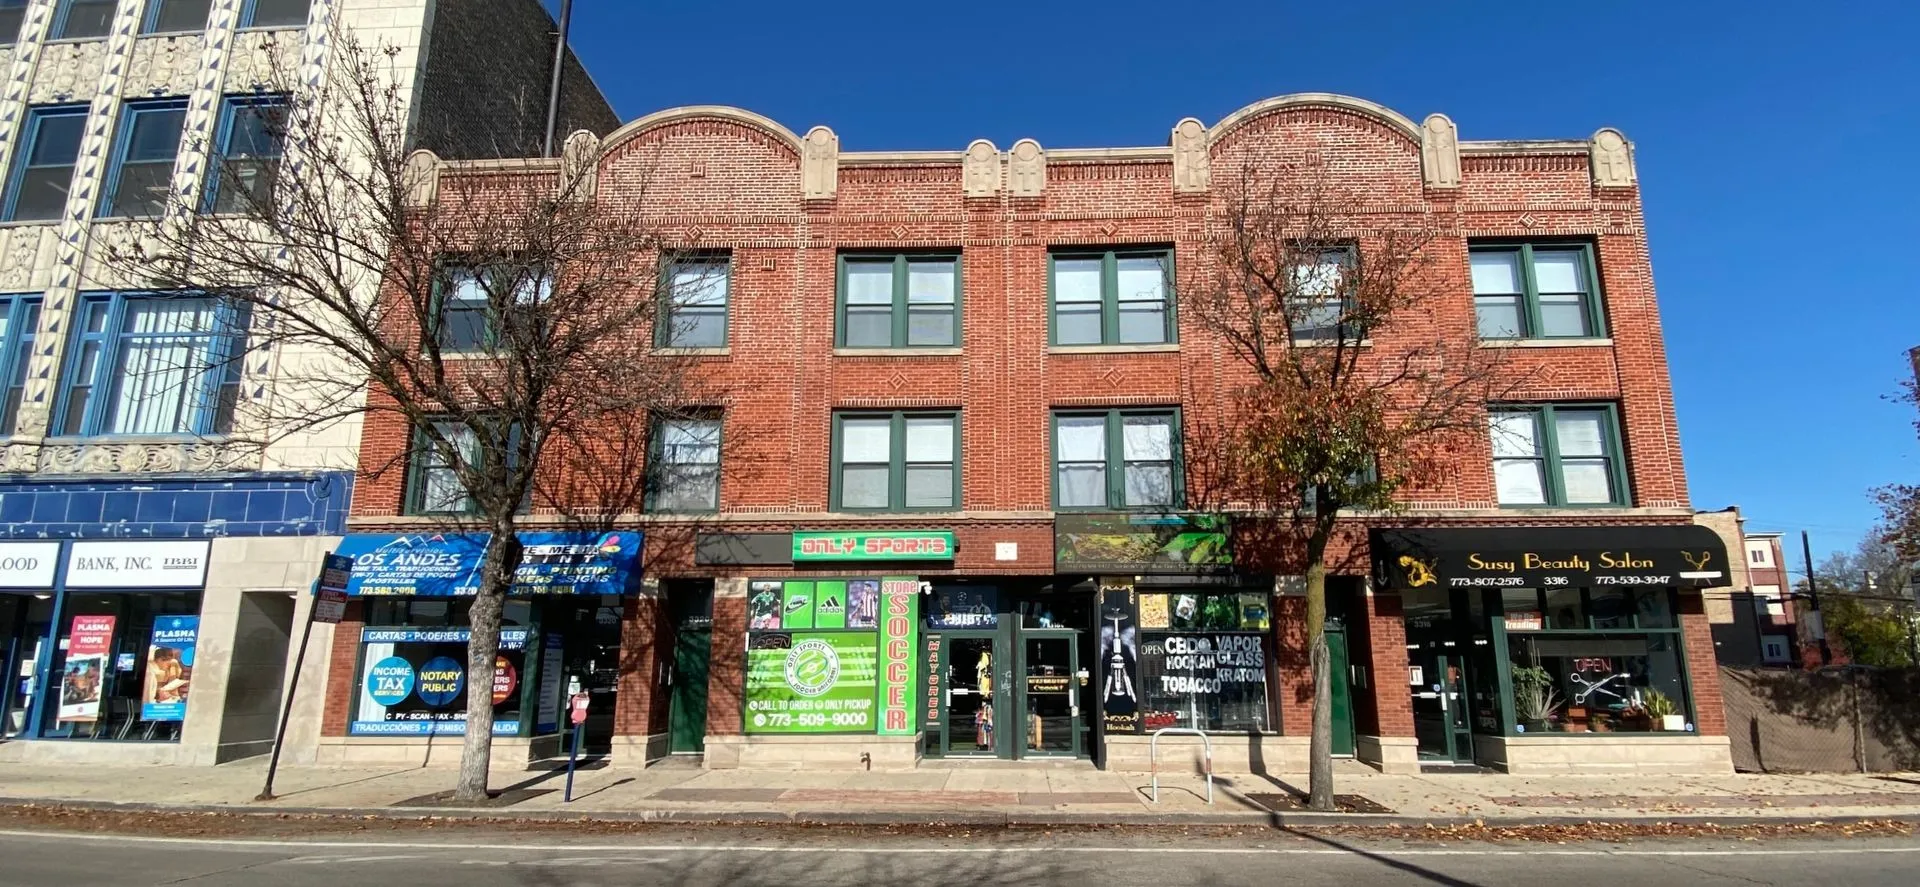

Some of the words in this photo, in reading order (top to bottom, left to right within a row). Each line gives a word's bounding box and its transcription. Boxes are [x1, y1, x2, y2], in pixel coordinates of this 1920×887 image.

[802, 538, 857, 554] ONLY
[865, 537, 947, 554] SPORTS
[0, 557, 38, 571] OOD
[76, 556, 119, 572] BANK,
[124, 556, 153, 570] INC.
[388, 553, 462, 566] ANDES
[521, 555, 596, 564] RINT
[1467, 552, 1516, 573] Susy
[1524, 552, 1591, 572] Beauty
[1598, 551, 1655, 569] Salon
[377, 571, 411, 579] CARTAS
[551, 566, 617, 576] PRINTING
[566, 574, 611, 583] SIGNS
[1450, 576, 1525, 586] 773-807-2576
[1544, 576, 1569, 585] 3316
[1595, 575, 1670, 585] 773-539-3947
[883, 580, 918, 594] STORE
[77, 623, 111, 631] PLASMA
[155, 629, 196, 638] PLASMA
[368, 631, 407, 640] CARTAS
[414, 631, 459, 640] PODERES
[80, 636, 104, 644] HOPE
[1216, 635, 1262, 652] VAPOR
[1141, 644, 1164, 655] OPEN
[886, 594, 910, 731] SOCCER
[1165, 655, 1216, 670] HOOKAH
[1216, 651, 1264, 666] GLASS
[1574, 656, 1612, 673] OPEN
[373, 667, 411, 676] INCOME
[420, 671, 462, 681] NOTARY
[1216, 668, 1265, 682] KRATOM
[376, 677, 405, 690] TAX
[422, 683, 458, 692] PUBLIC
[1161, 675, 1222, 694] TOBACCO
[758, 700, 777, 711] CALL
[779, 700, 788, 710] TO
[790, 700, 813, 710] ORDER
[825, 699, 843, 710] ONLY
[845, 698, 872, 709] PICKUP
[410, 712, 430, 720] SCAN
[768, 711, 868, 727] 773-509-9000
[427, 722, 467, 732] PERMISO
[492, 721, 519, 732] ALIDA
[1105, 723, 1136, 732] Hookah
